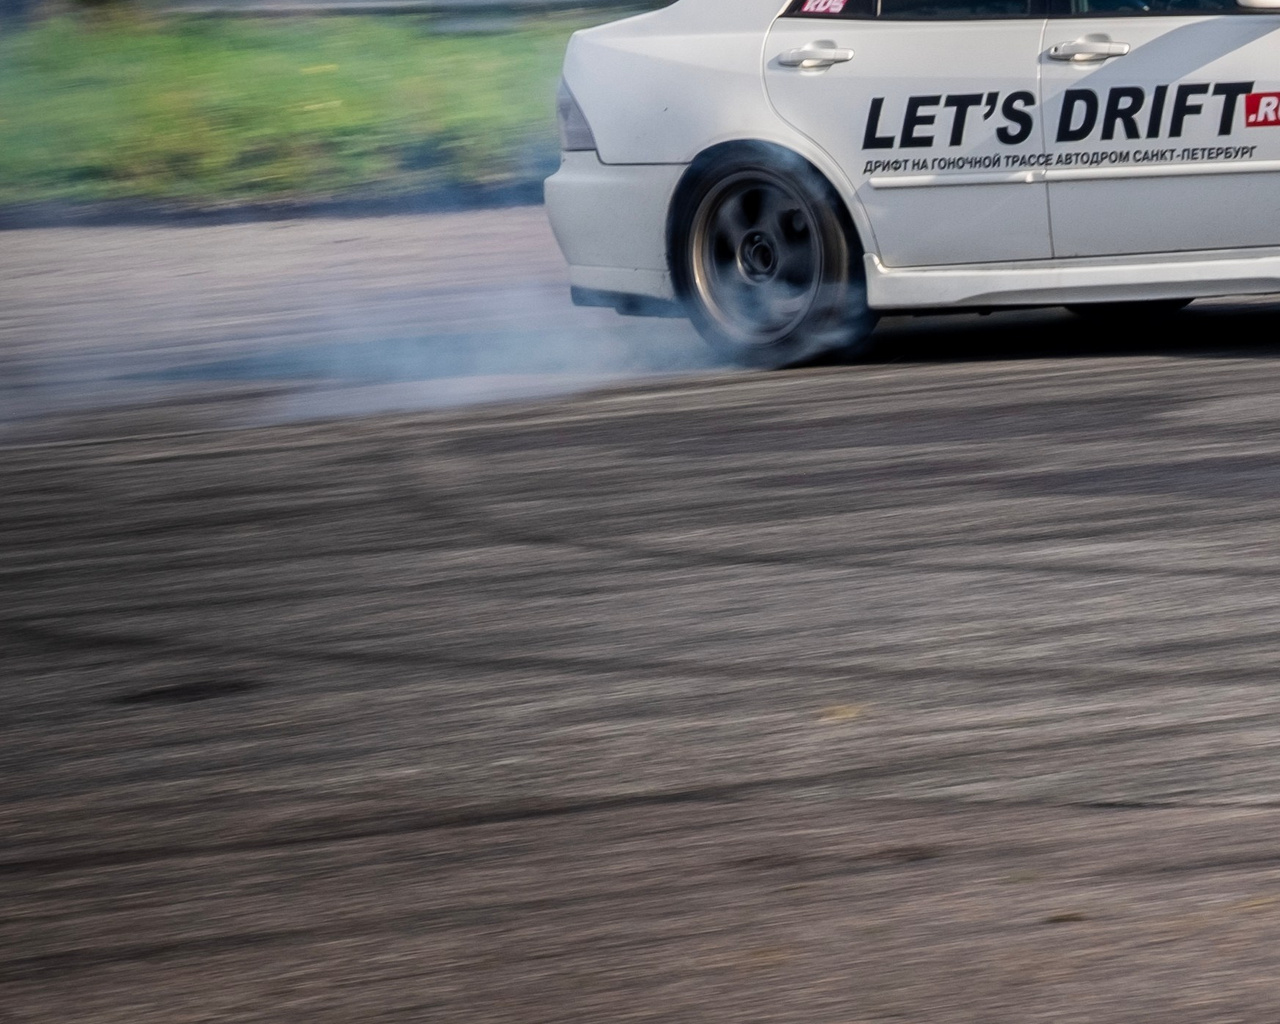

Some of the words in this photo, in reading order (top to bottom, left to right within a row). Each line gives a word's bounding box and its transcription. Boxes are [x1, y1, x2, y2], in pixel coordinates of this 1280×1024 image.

[862, 90, 1036, 150] LET'S
[863, 159, 910, 174] ДРИФТ
[912, 159, 929, 171] НА
[931, 153, 1001, 171] ГОНОЧНОЙ
[1004, 153, 1053, 167] ТРАССЕ
[1055, 150, 1130, 166] АВТОДРОМ
[1132, 145, 1257, 163] САНКТ-ПЕТЕРБУРГ
